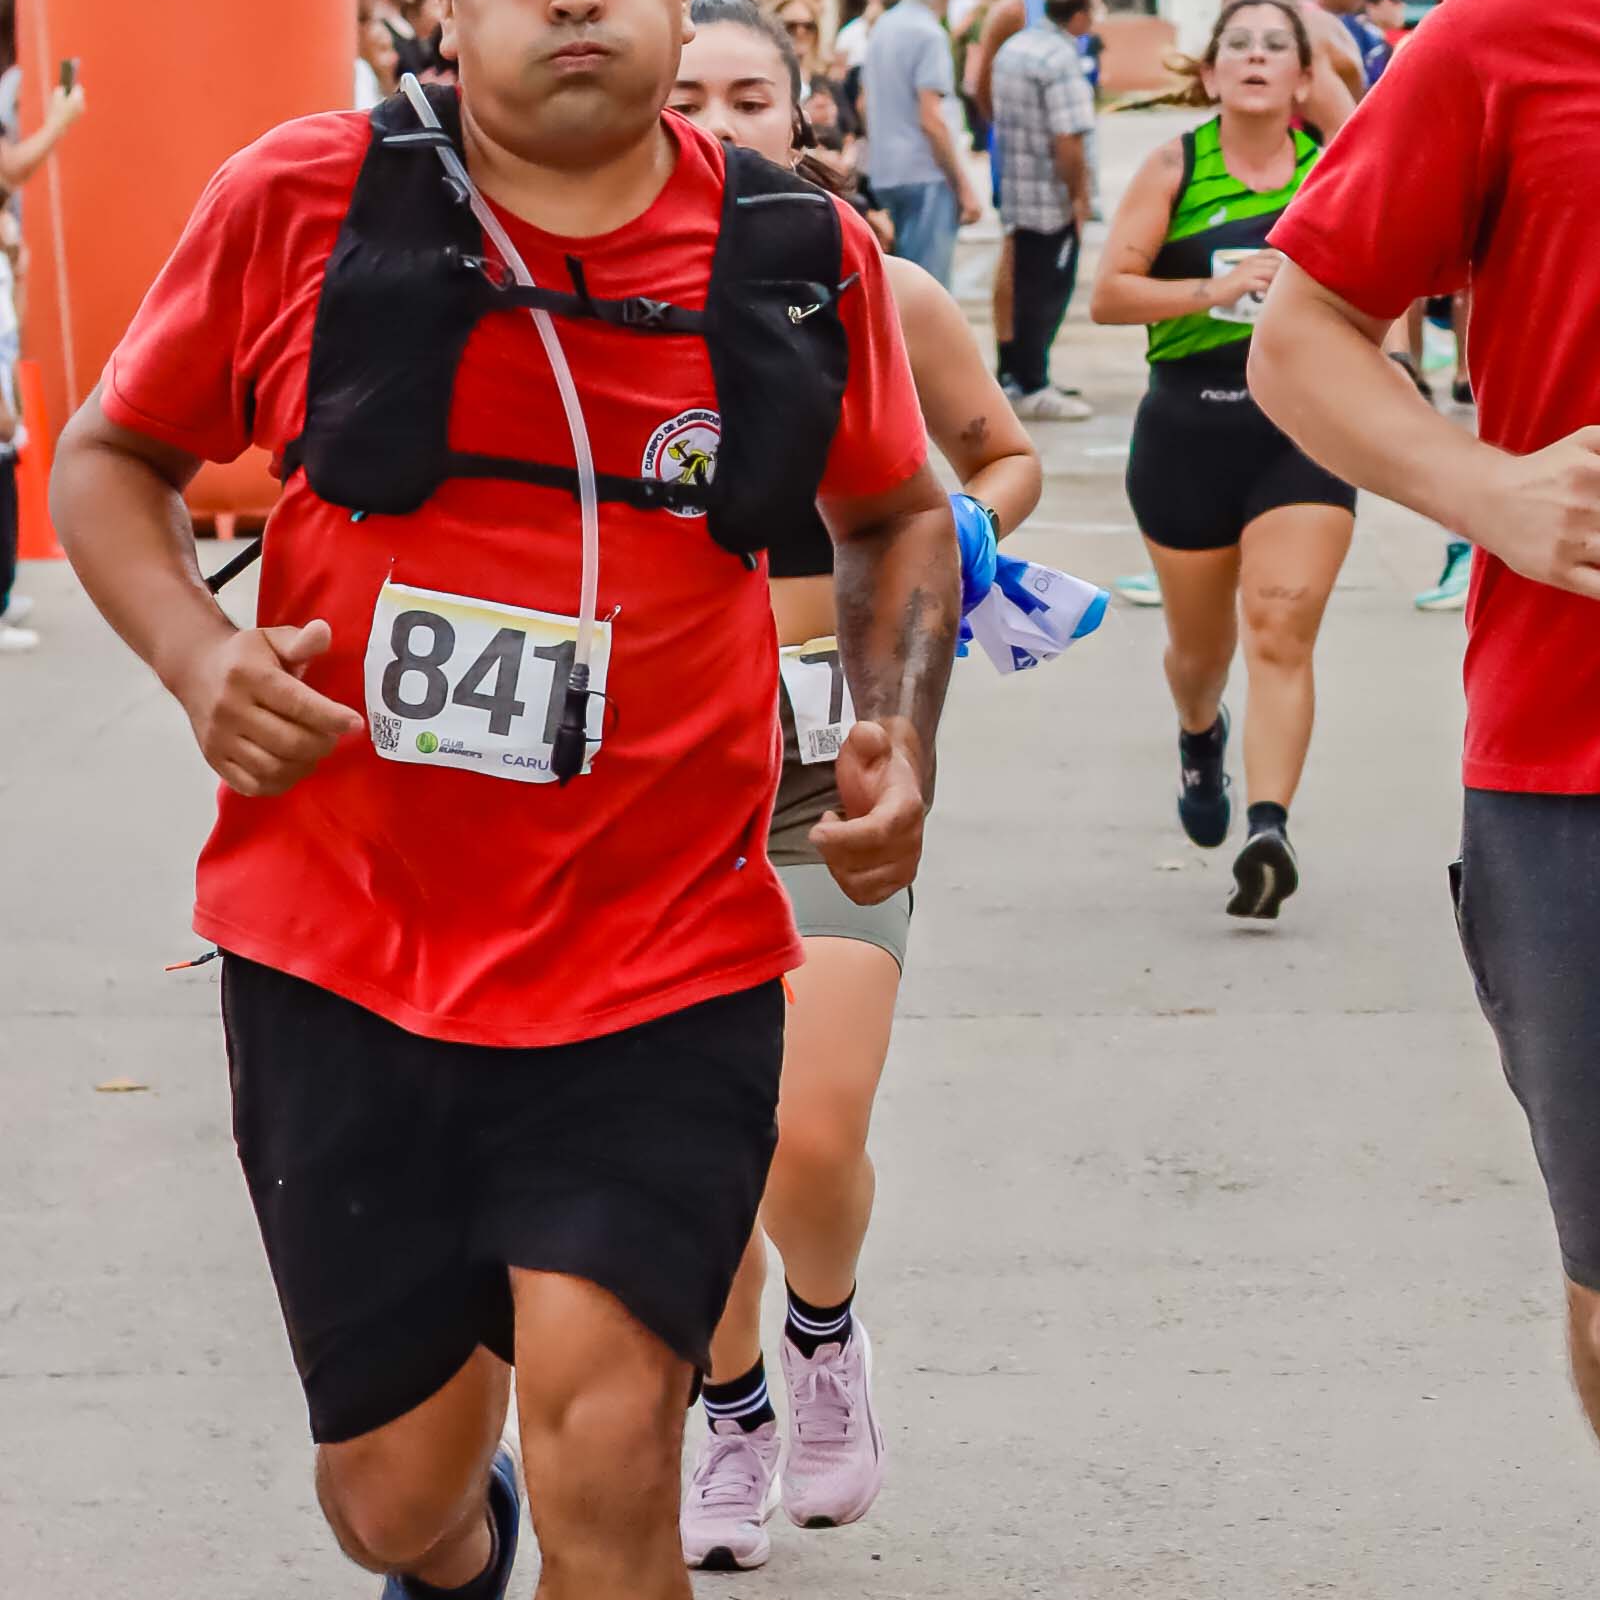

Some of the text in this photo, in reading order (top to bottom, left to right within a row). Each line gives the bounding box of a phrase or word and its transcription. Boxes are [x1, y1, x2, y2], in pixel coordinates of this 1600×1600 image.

[644, 412, 720, 471] CUERPO DE BOMBEROS
[381, 610, 577, 745] 841
